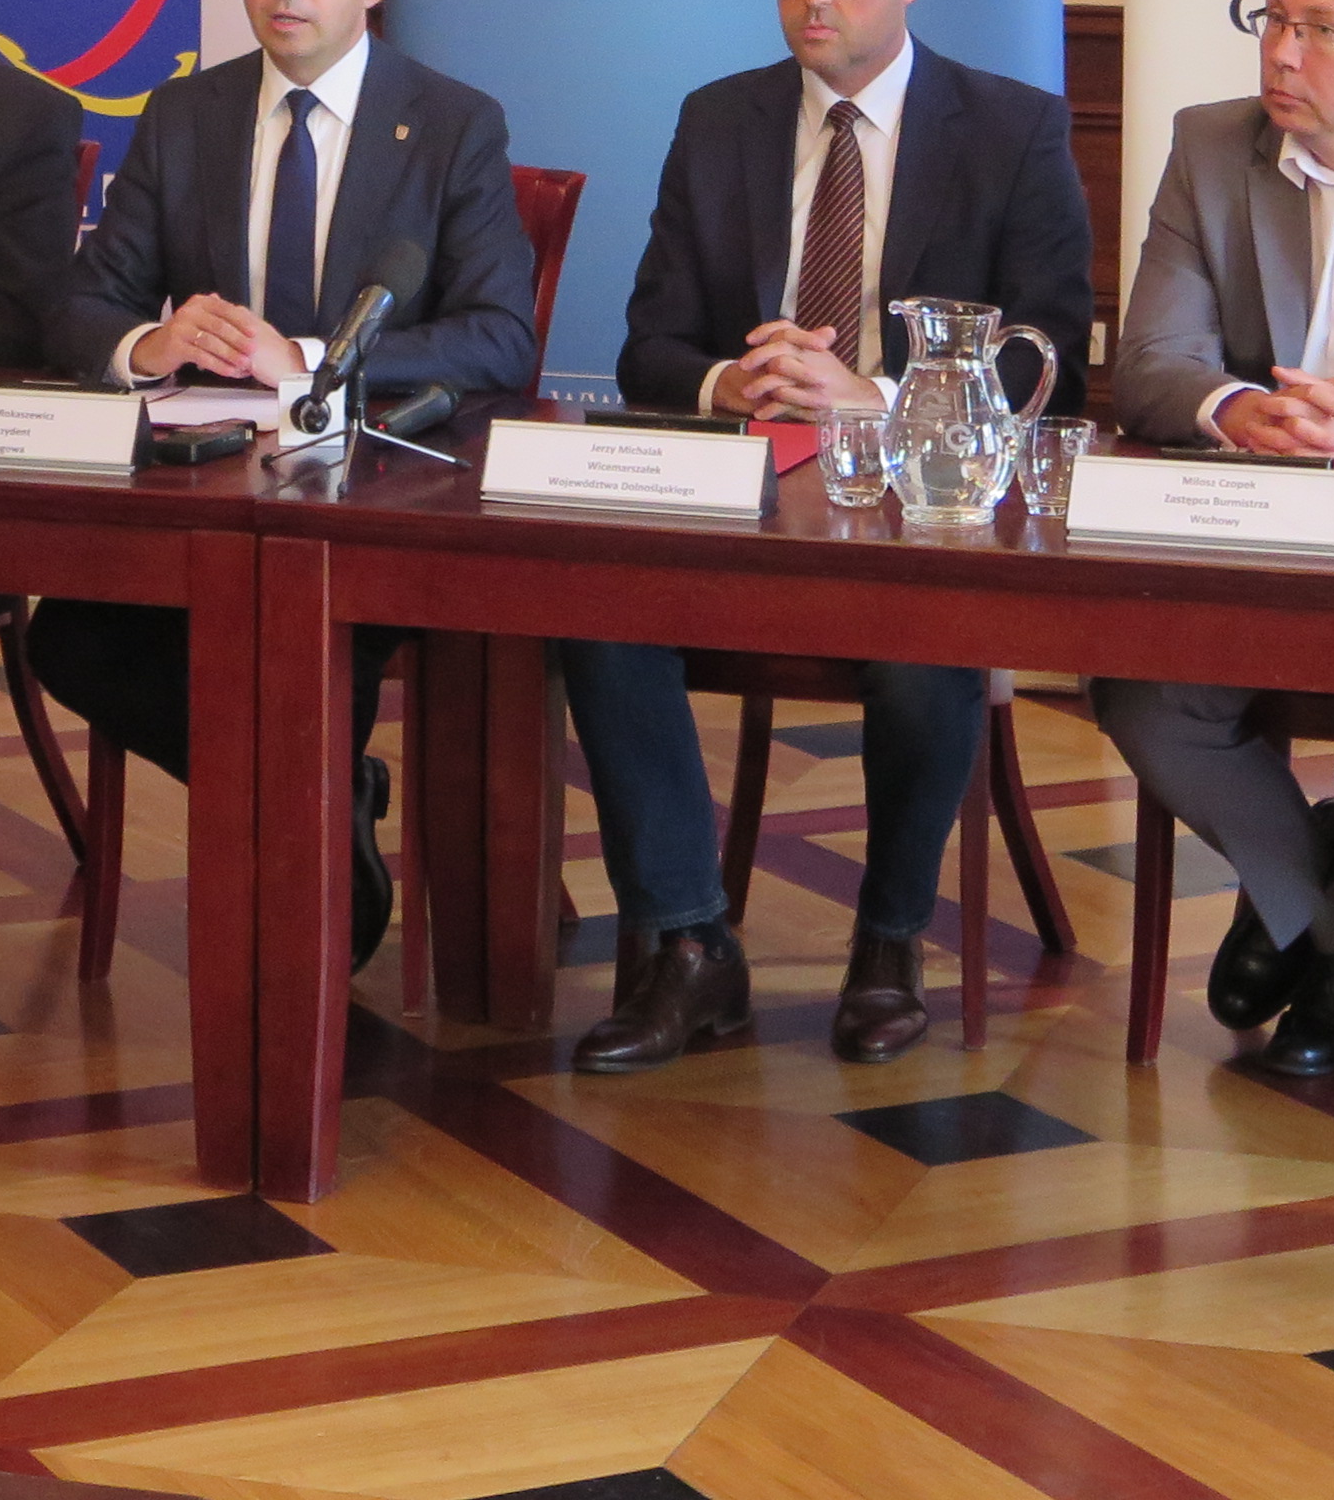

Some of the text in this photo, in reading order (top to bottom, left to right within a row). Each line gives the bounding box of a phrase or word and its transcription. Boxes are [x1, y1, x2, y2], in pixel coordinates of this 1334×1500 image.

[590, 443, 663, 457] Jerzy Michalak
[587, 461, 662, 475] Wicemarszałek
[547, 476, 695, 497] Województwa Dolnośląskiego
[1218, 478, 1257, 491] Czopek
[1163, 493, 1270, 509] Zastępca Burmistrza
[1189, 514, 1240, 528] Wschowy
